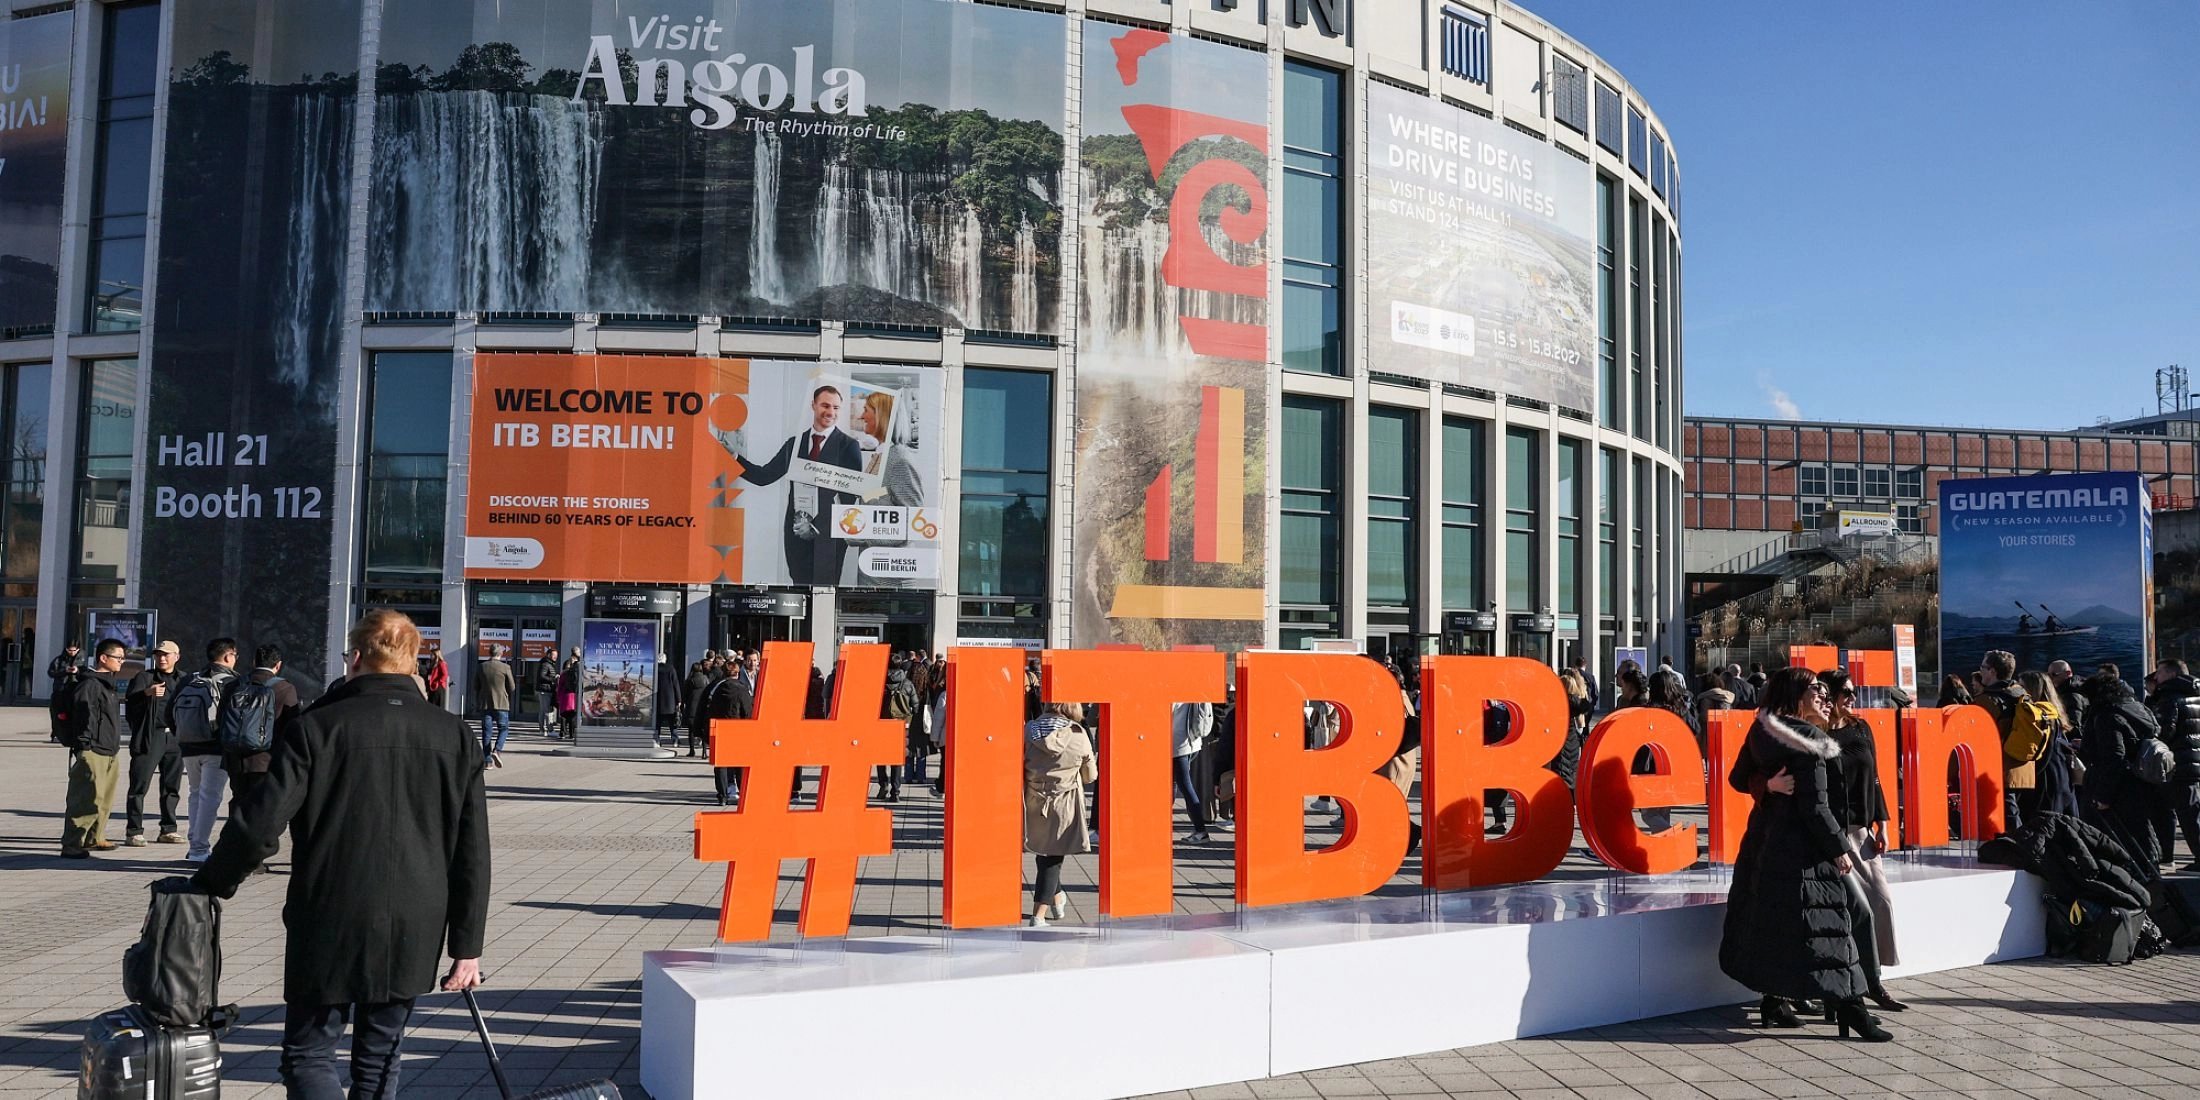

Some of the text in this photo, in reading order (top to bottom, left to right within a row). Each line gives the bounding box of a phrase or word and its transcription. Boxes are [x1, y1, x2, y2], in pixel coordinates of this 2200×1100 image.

[628, 14, 723, 51] Visit
[572, 35, 868, 130] Angola
[744, 117, 906, 141] The Rhythm of Life
[1388, 113, 1533, 181] WHERE IDEAS
[1388, 143, 1556, 217] DRIVE BUSINESS
[1389, 178, 1512, 228] VISIT US AT HALL 1.1
[1389, 198, 1459, 230] STAND 124
[1493, 328, 1517, 349] 15.5
[1528, 338, 1581, 366] 15.8.2027
[494, 388, 703, 415] WELCOME TO
[493, 423, 674, 449] ITB BERLIN!
[158, 432, 267, 467] Hall 21
[804, 462, 864, 483] Creating moments
[814, 476, 850, 489] since 1966
[155, 484, 322, 518] Booth 112
[489, 495, 650, 509] DISCOVER THE STORIES
[1950, 487, 2128, 511] GUATEMALA
[488, 512, 696, 528] BEHIND 60 YEARS OF LEGACY.
[873, 510, 899, 524] ITB
[1851, 518, 1888, 526] ALLROUND
[1964, 514, 2113, 526] NEW SEASON AVAILABLE
[872, 527, 899, 536] BERLIN
[1999, 534, 2076, 548] YOUR STORIES
[503, 546, 528, 555] Angola
[890, 558, 917, 566] MESSE
[890, 564, 917, 572] BERLIN
